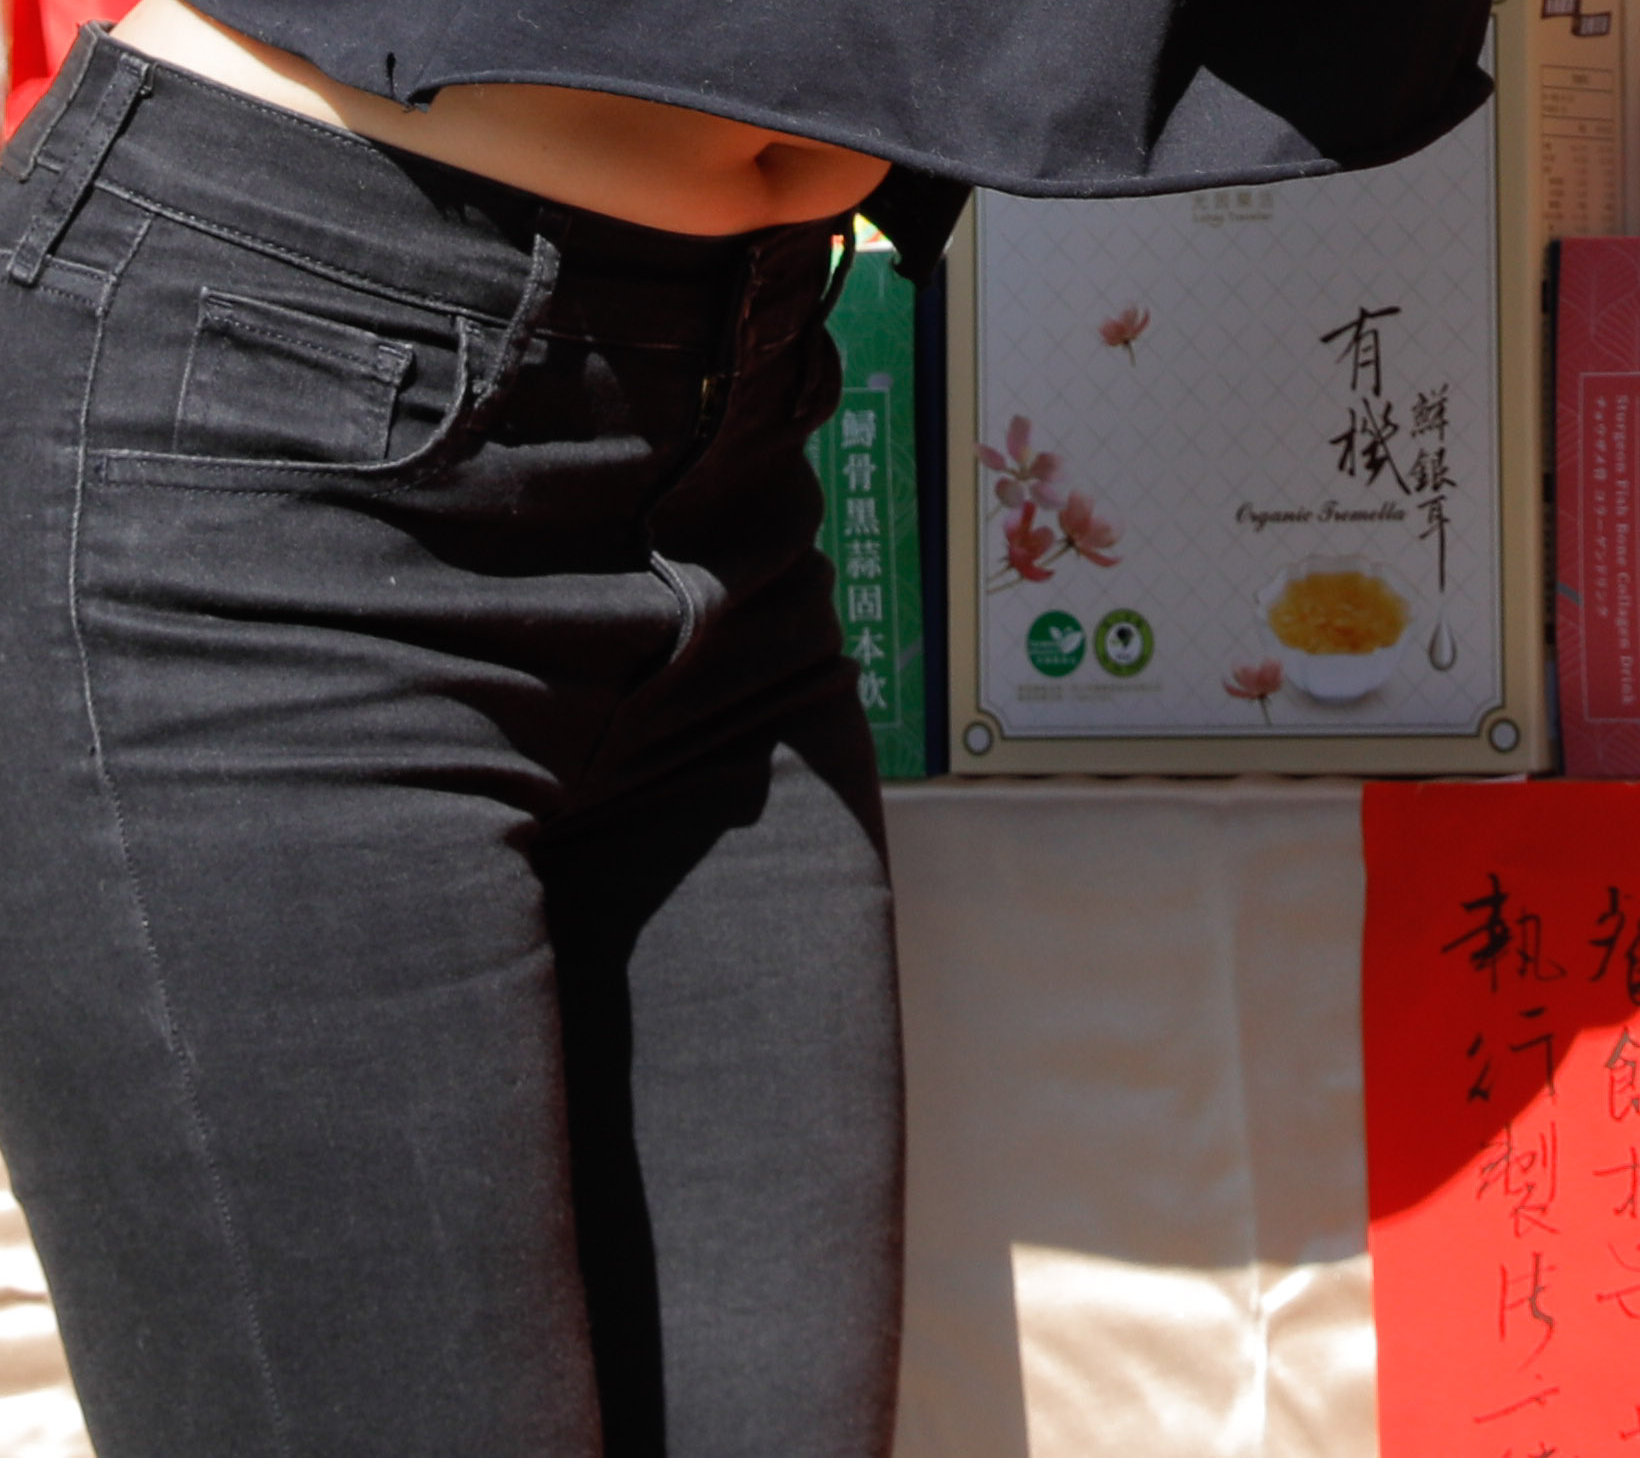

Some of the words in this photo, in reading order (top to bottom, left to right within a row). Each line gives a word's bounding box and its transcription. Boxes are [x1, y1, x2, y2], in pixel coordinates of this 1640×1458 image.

[1319, 305, 1412, 496] 有機
[1615, 394, 1629, 474] Sturgeon
[1235, 501, 1313, 532] Organic
[1317, 500, 1406, 523] Tremella
[1410, 383, 1457, 593] 鮮銀耳
[1615, 479, 1630, 516] Fish
[1616, 522, 1631, 567] Bone
[1616, 572, 1632, 649] Collagen
[1620, 655, 1636, 706] Drink
